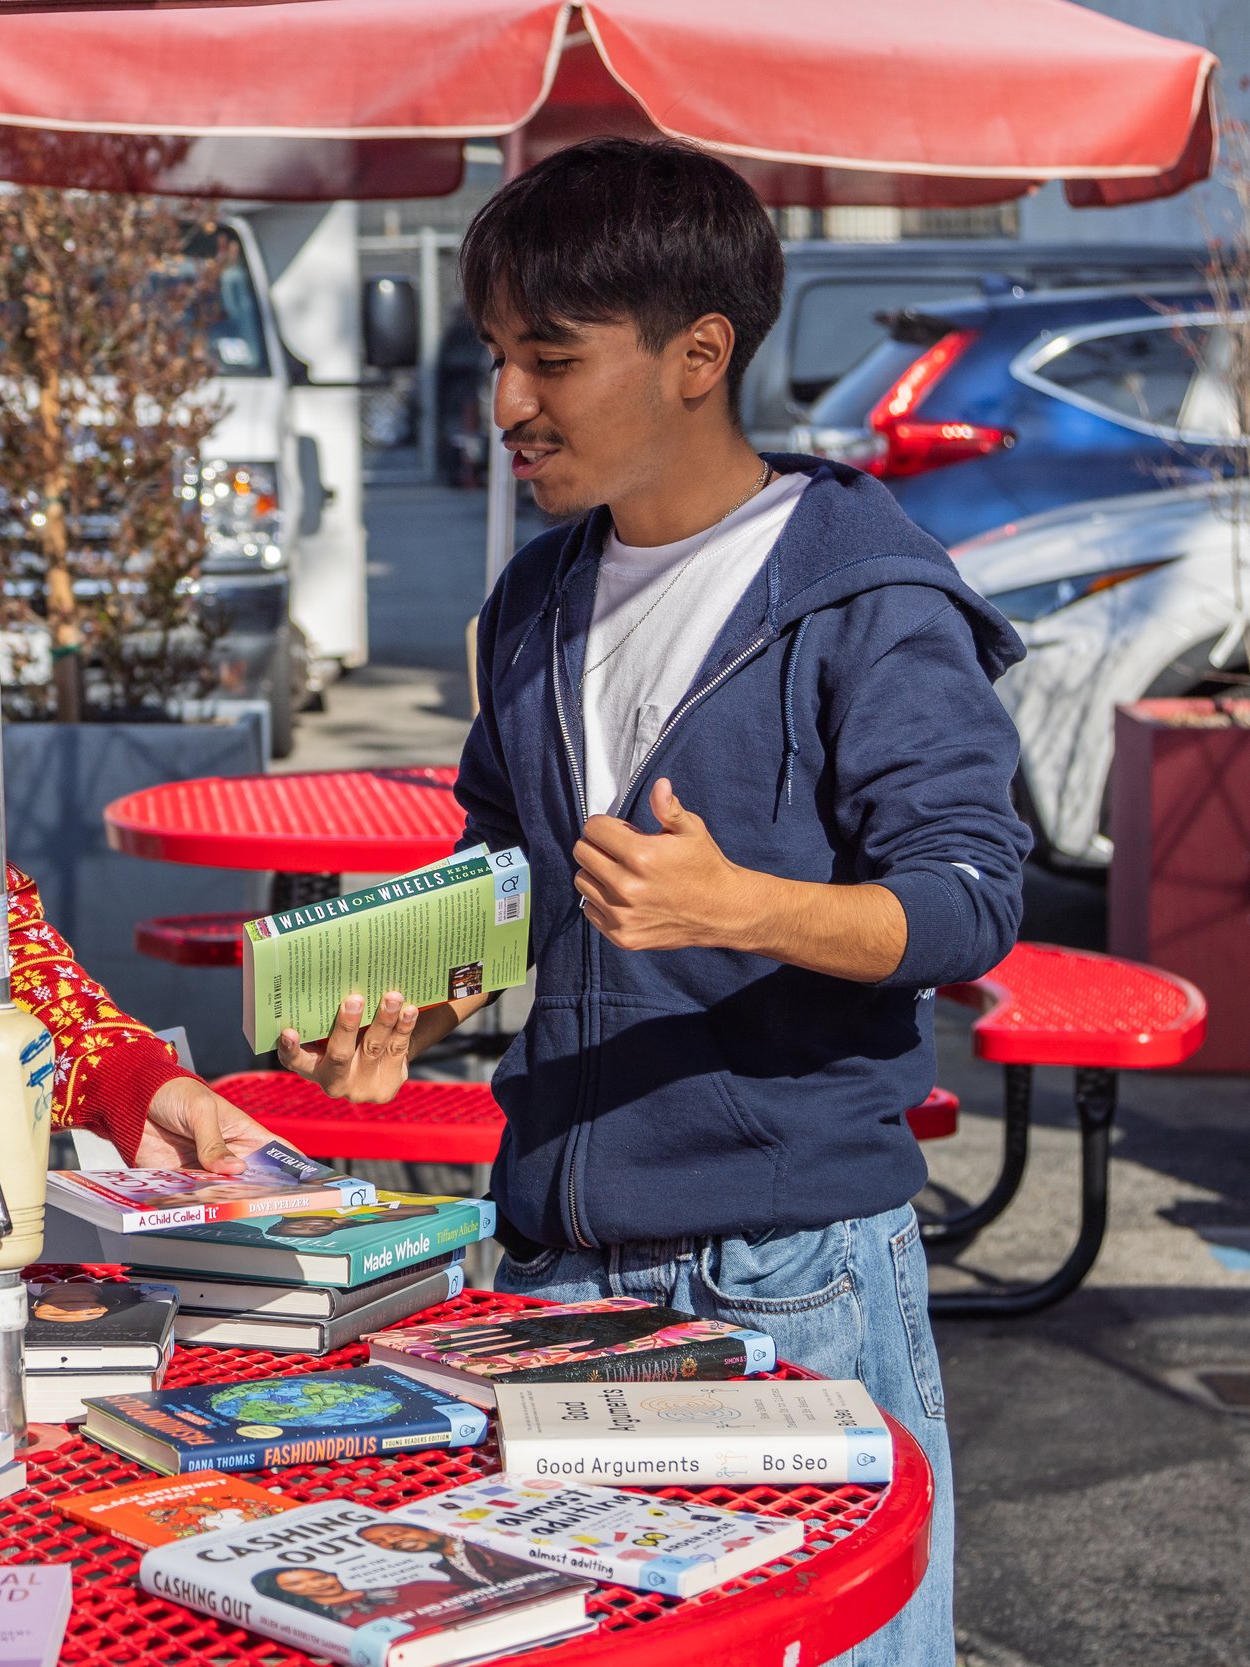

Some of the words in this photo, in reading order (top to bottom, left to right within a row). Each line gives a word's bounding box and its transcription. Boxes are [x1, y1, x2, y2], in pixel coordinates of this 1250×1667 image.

[446, 864, 469, 876] KEN
[450, 865, 492, 882] ILGUNA
[278, 899, 350, 930] WALDEN
[351, 892, 376, 907] ON
[377, 871, 445, 902] WHEELS
[273, 974, 281, 986] WHEELS
[266, 1146, 298, 1170] PELZER
[139, 1217, 146, 1227] A
[148, 1212, 171, 1226] Child
[173, 1208, 201, 1224] Called
[249, 1203, 272, 1214] DAVE
[275, 1197, 310, 1211] PELZER
[436, 1226, 457, 1245] Tiffany
[458, 1220, 479, 1237] Aliche
[363, 1249, 393, 1274] Made
[395, 1236, 431, 1262] Whole
[606, 1358, 678, 1381] LUMINARY
[724, 1357, 740, 1366] SIMON
[383, 1375, 427, 1393] THOMAS
[420, 1391, 452, 1404] DANA
[104, 1396, 215, 1446] FASHIONOPOLIS
[558, 1400, 588, 1422] Good
[599, 1387, 638, 1433] Arguments
[832, 1409, 852, 1418] Seo
[405, 1437, 428, 1445] READERS
[430, 1433, 450, 1442] EDITION
[188, 1459, 214, 1471] DANA
[217, 1453, 255, 1468] THOMAS
[264, 1437, 377, 1466] FASHIONOPOLIS
[763, 1455, 786, 1470] Bo
[794, 1455, 827, 1470] Seo
[536, 1459, 585, 1475] Good
[591, 1455, 700, 1475] Arguments
[89, 1494, 144, 1513] BLACK
[144, 1479, 228, 1497] INTERNET
[136, 1489, 197, 1507] EFFECT
[496, 1487, 593, 1527] almost
[530, 1492, 652, 1538] adulting
[195, 1510, 379, 1563] CASHING
[664, 1533, 704, 1553] ARDEN
[702, 1521, 736, 1542] ROSE
[276, 1535, 355, 1566] OUT
[529, 1547, 568, 1566] almost
[570, 1557, 614, 1579] adulting
[152, 1571, 218, 1611] CASHING
[221, 1598, 253, 1622] OUT
